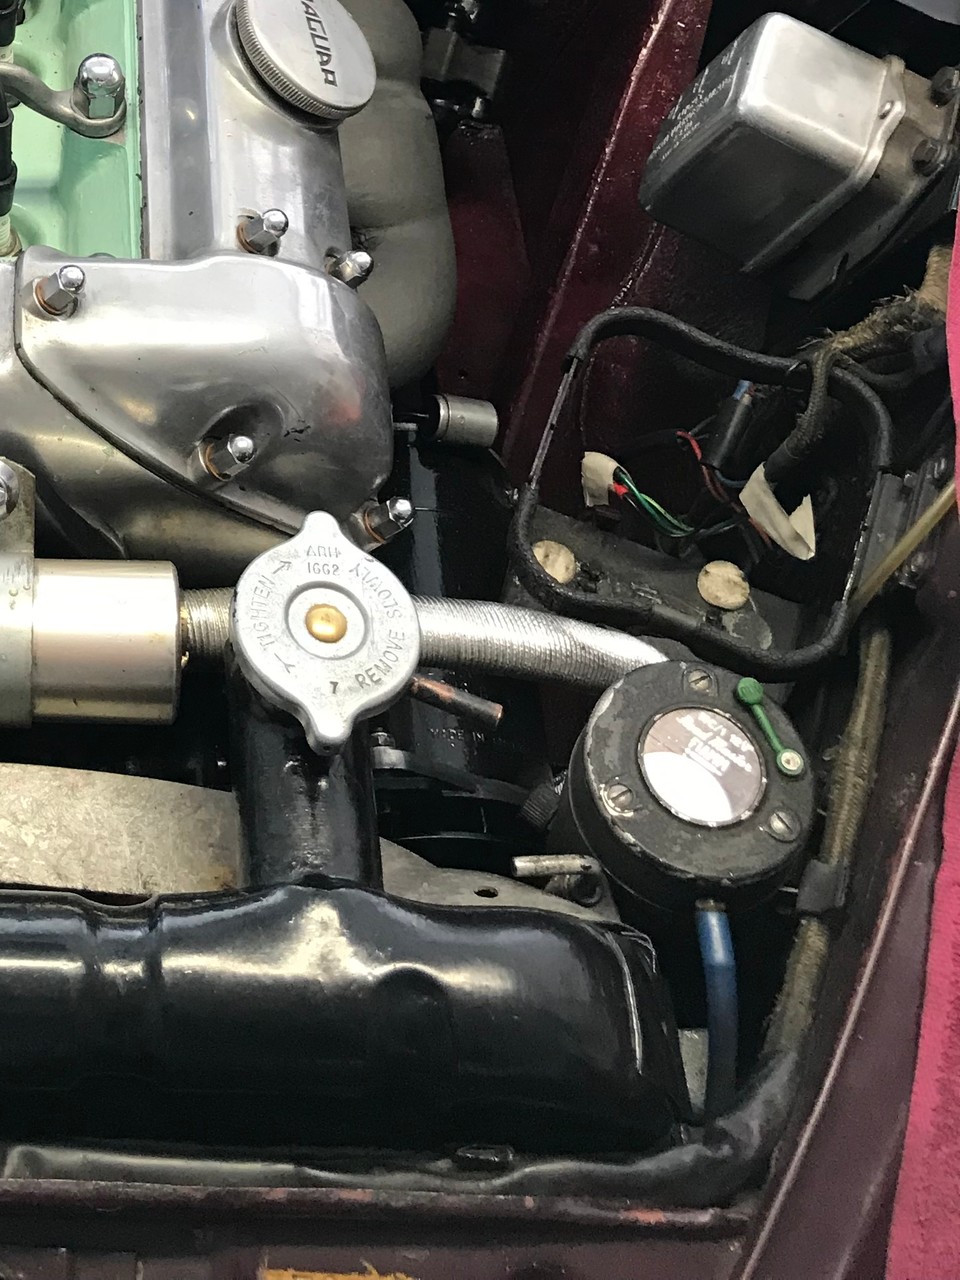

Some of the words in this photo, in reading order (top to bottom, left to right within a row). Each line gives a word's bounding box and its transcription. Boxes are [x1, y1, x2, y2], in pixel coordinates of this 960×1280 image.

[307, 562, 340, 576] 1662
[348, 562, 403, 620] SLOWLY
[250, 574, 277, 652] TIGHTEN
[354, 629, 405, 689] REMOVE
[472, 731, 485, 742] IN
